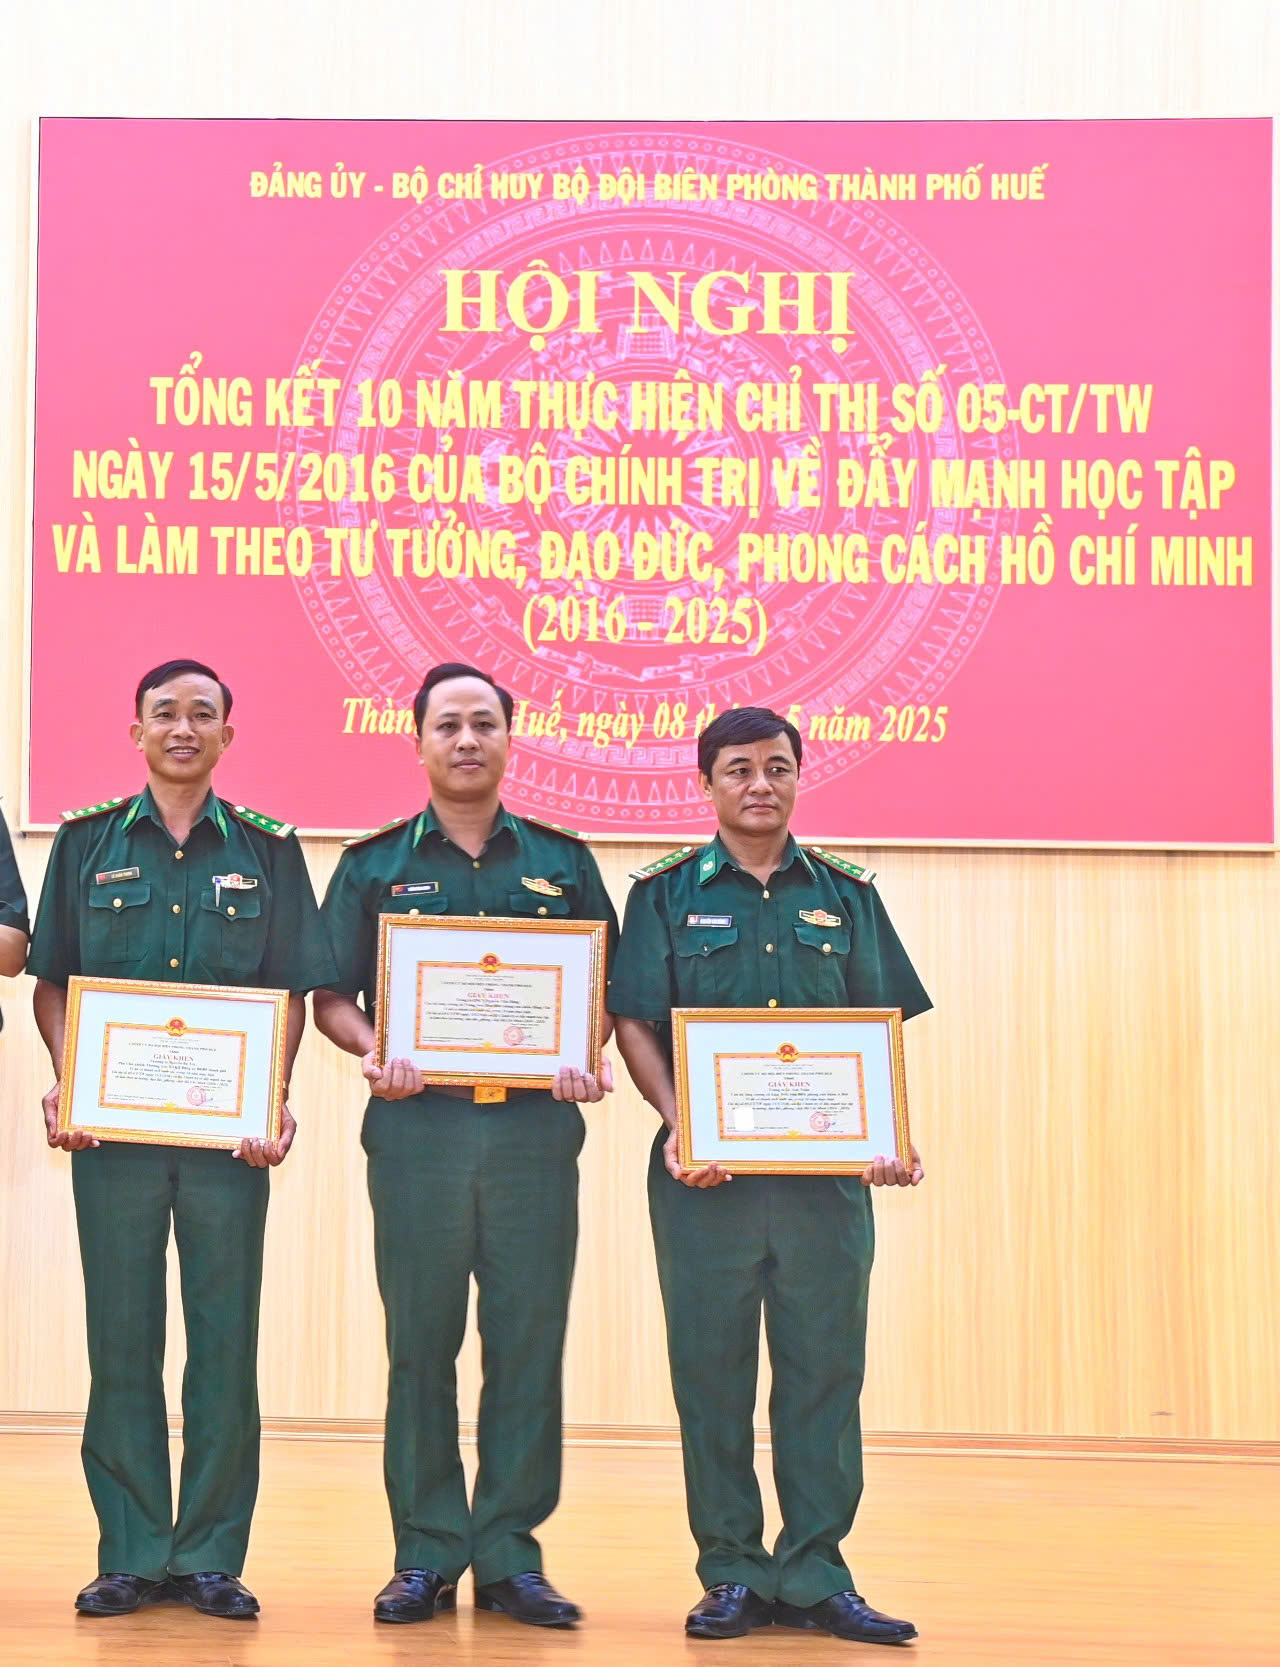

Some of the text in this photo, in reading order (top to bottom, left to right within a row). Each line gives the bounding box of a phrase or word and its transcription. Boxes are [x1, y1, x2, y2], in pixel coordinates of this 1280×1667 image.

[250, 161, 1050, 206] ĐẢNG ỦY - BỘ CHỈ HUY BỘ ĐỘI BIÊN PHÒNG THÀNH PHỐ HUẾ
[439, 259, 856, 354] HỘI NGHỊ
[149, 351, 1154, 444] TỔNG KẾT 10 NĂM THỰC HIỆN CHỈ THỊ SỐ 05-CT/TW
[73, 432, 1236, 520] NGÀY 15/5/2016 CỦA BỘ CHÍNH TRỊ VỀ ĐẨY MẠNH HỌC TẬP
[52, 509, 1253, 592] VÀ LÀM THEO TƯ TƯỞNG, ĐẠO ĐỨC, PHONG CÁCH HỒ CHÍ MINH
[523, 594, 768, 656] (2016 - 2025)
[343, 697, 418, 735] Thàn
[576, 701, 644, 749] ngày
[653, 702, 688, 740] 08
[808, 704, 871, 742] năm
[879, 704, 949, 743] 2025
